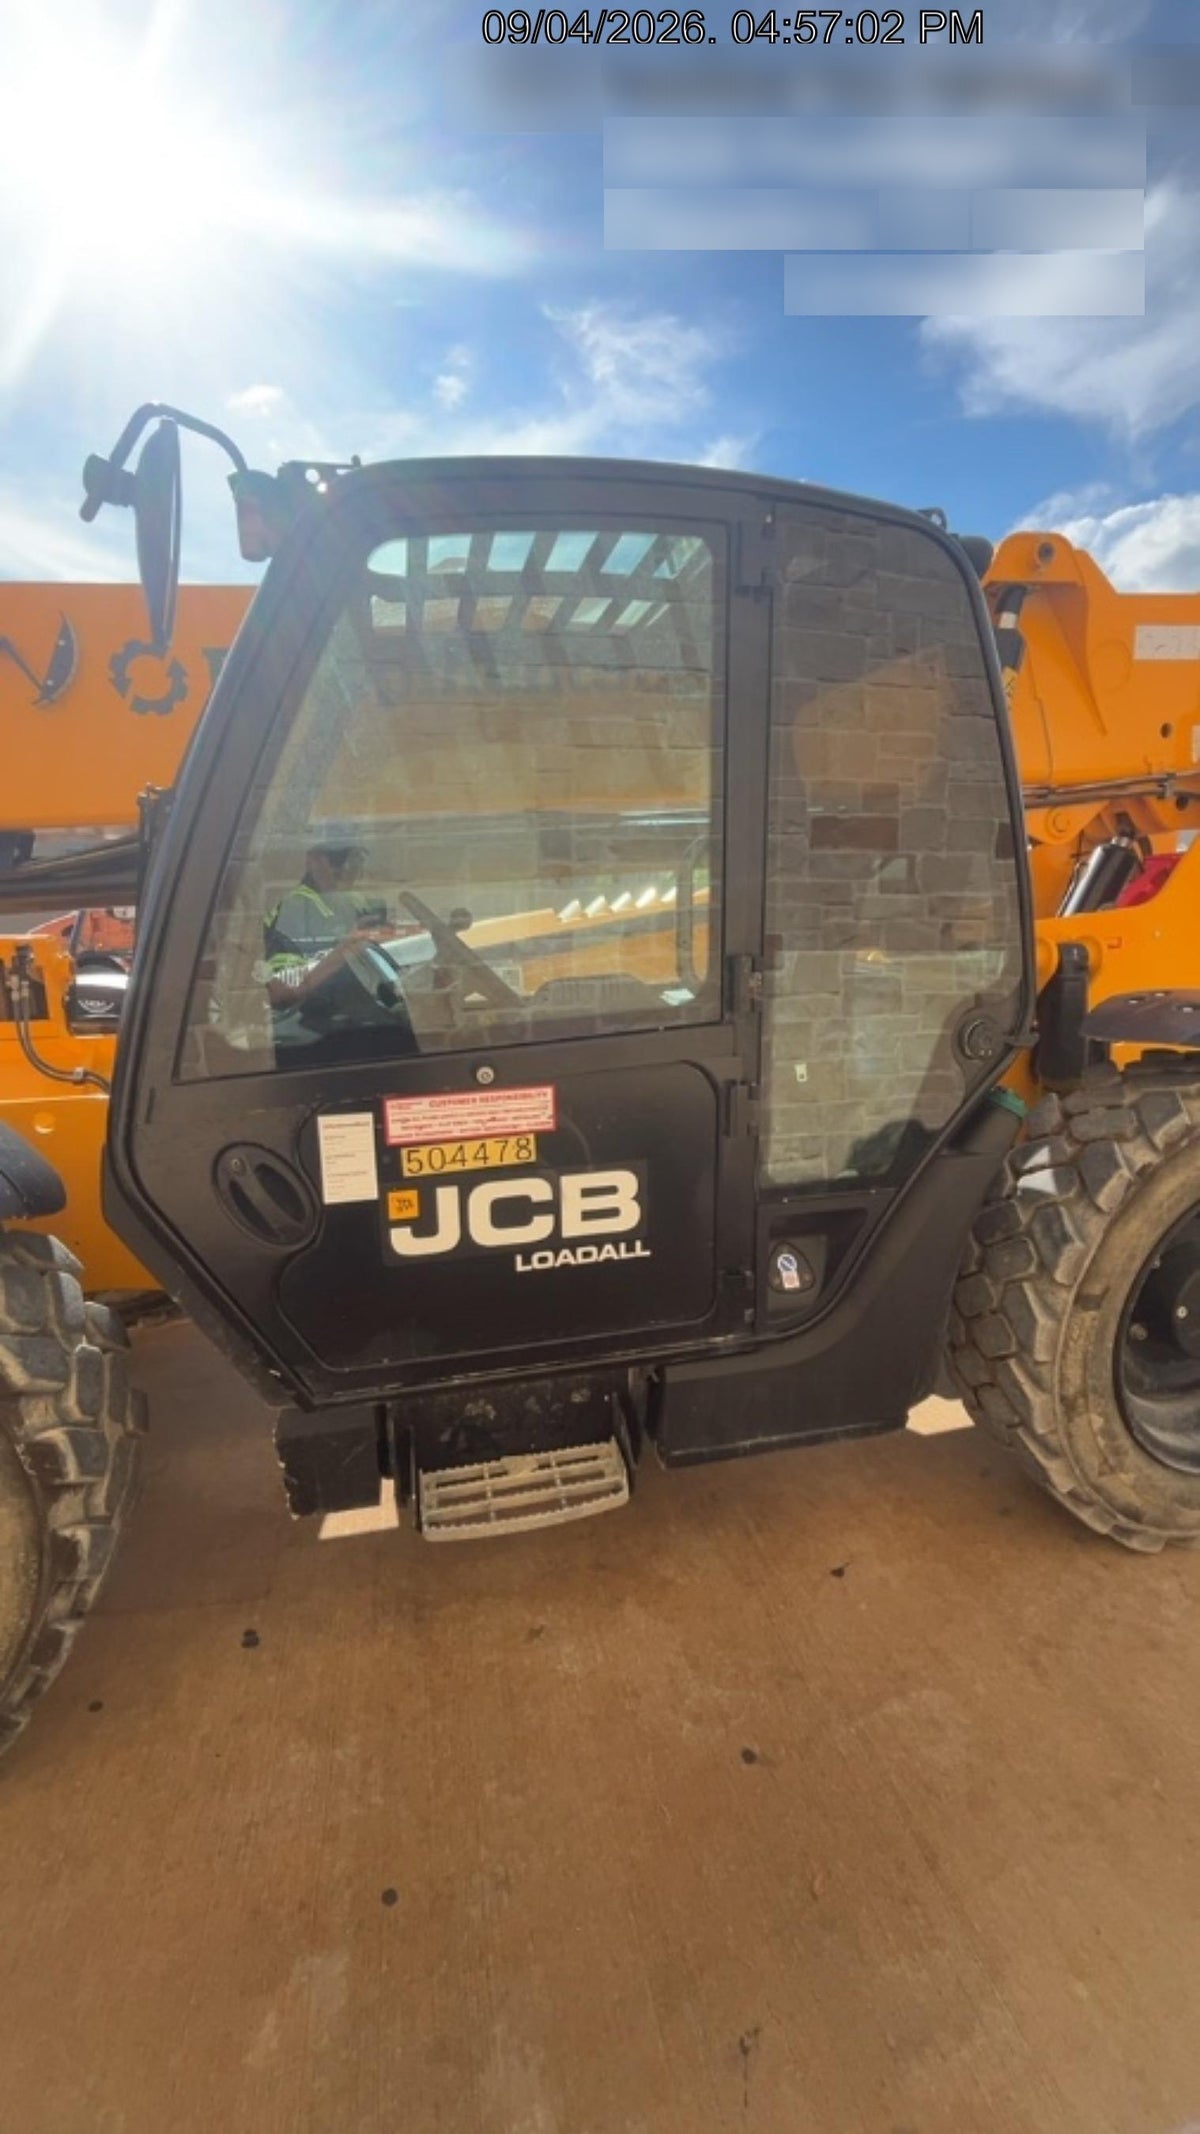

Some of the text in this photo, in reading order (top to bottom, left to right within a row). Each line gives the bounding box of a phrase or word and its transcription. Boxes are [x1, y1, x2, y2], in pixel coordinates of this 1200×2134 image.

[428, 1096, 478, 1108] CUSTOMER
[406, 1136, 533, 1174] 504478
[389, 1169, 642, 1256] JCB
[514, 1239, 652, 1272] LOADALL
